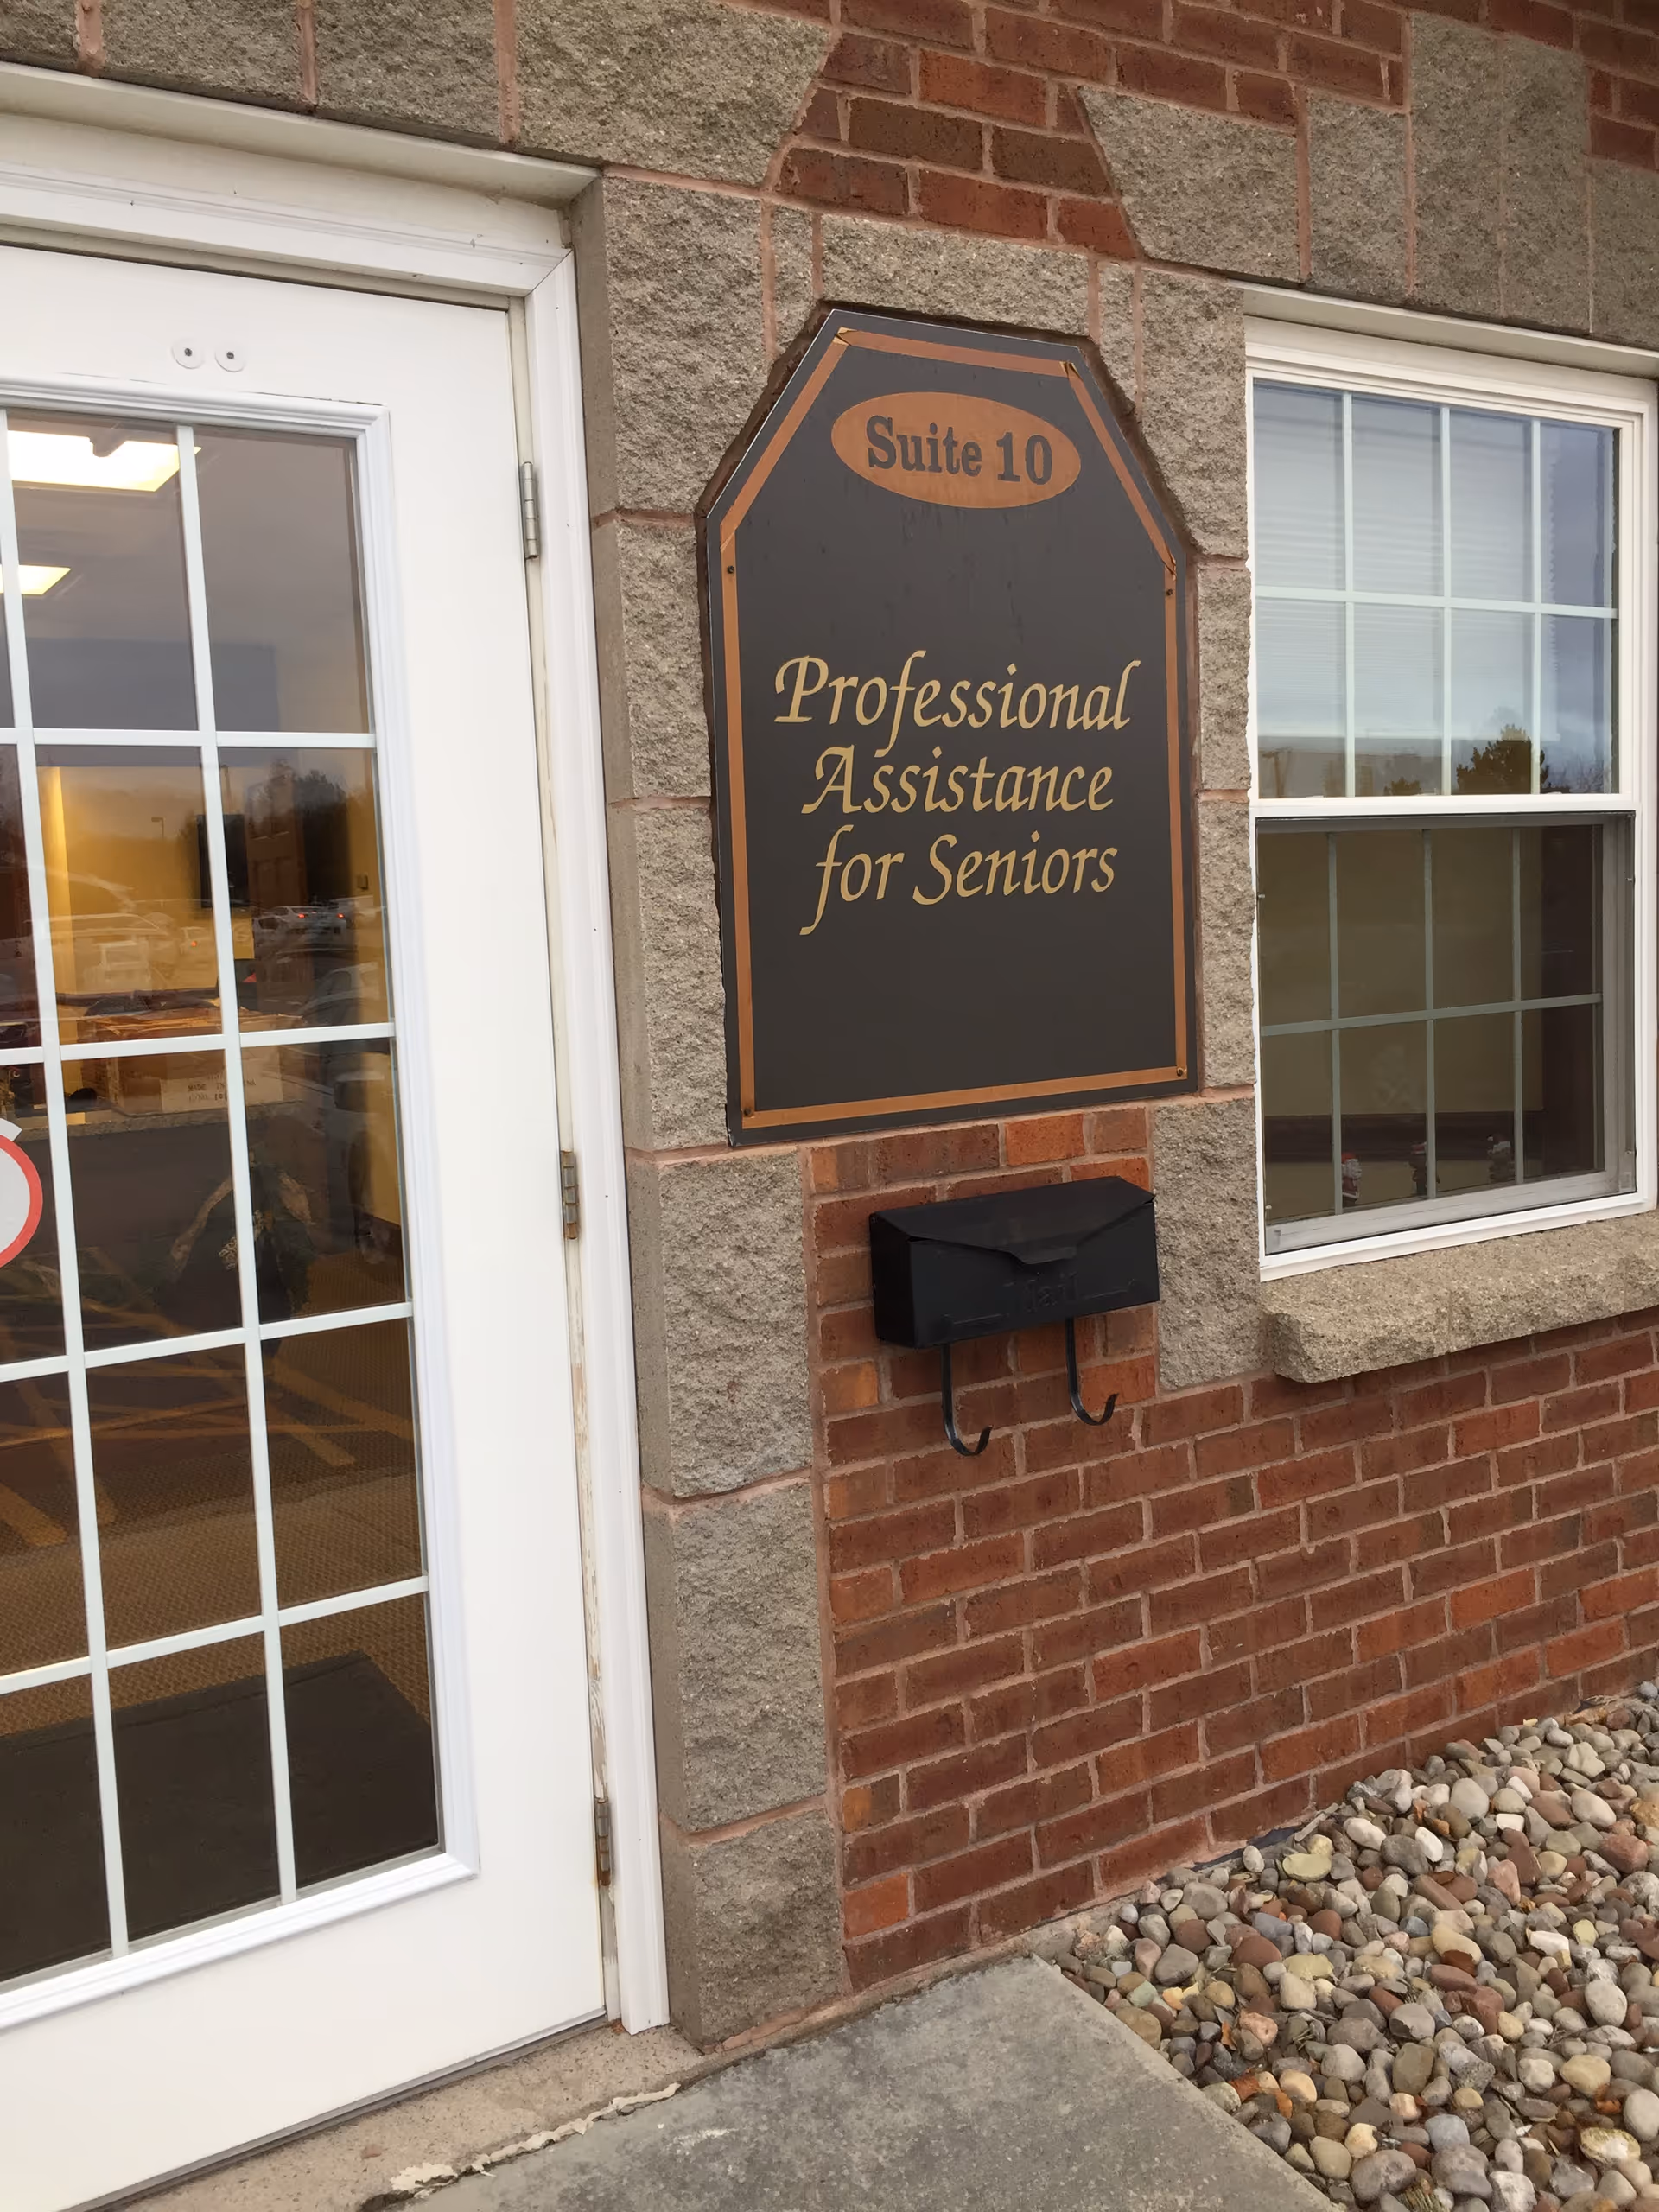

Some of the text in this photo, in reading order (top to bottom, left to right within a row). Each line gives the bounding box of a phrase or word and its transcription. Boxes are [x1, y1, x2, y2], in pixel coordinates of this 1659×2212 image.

[866, 415, 1053, 486] Suite 10
[774, 650, 1141, 758] Professional
[801, 744, 1113, 814] Assistance
[799, 824, 1118, 936] for Seniors
